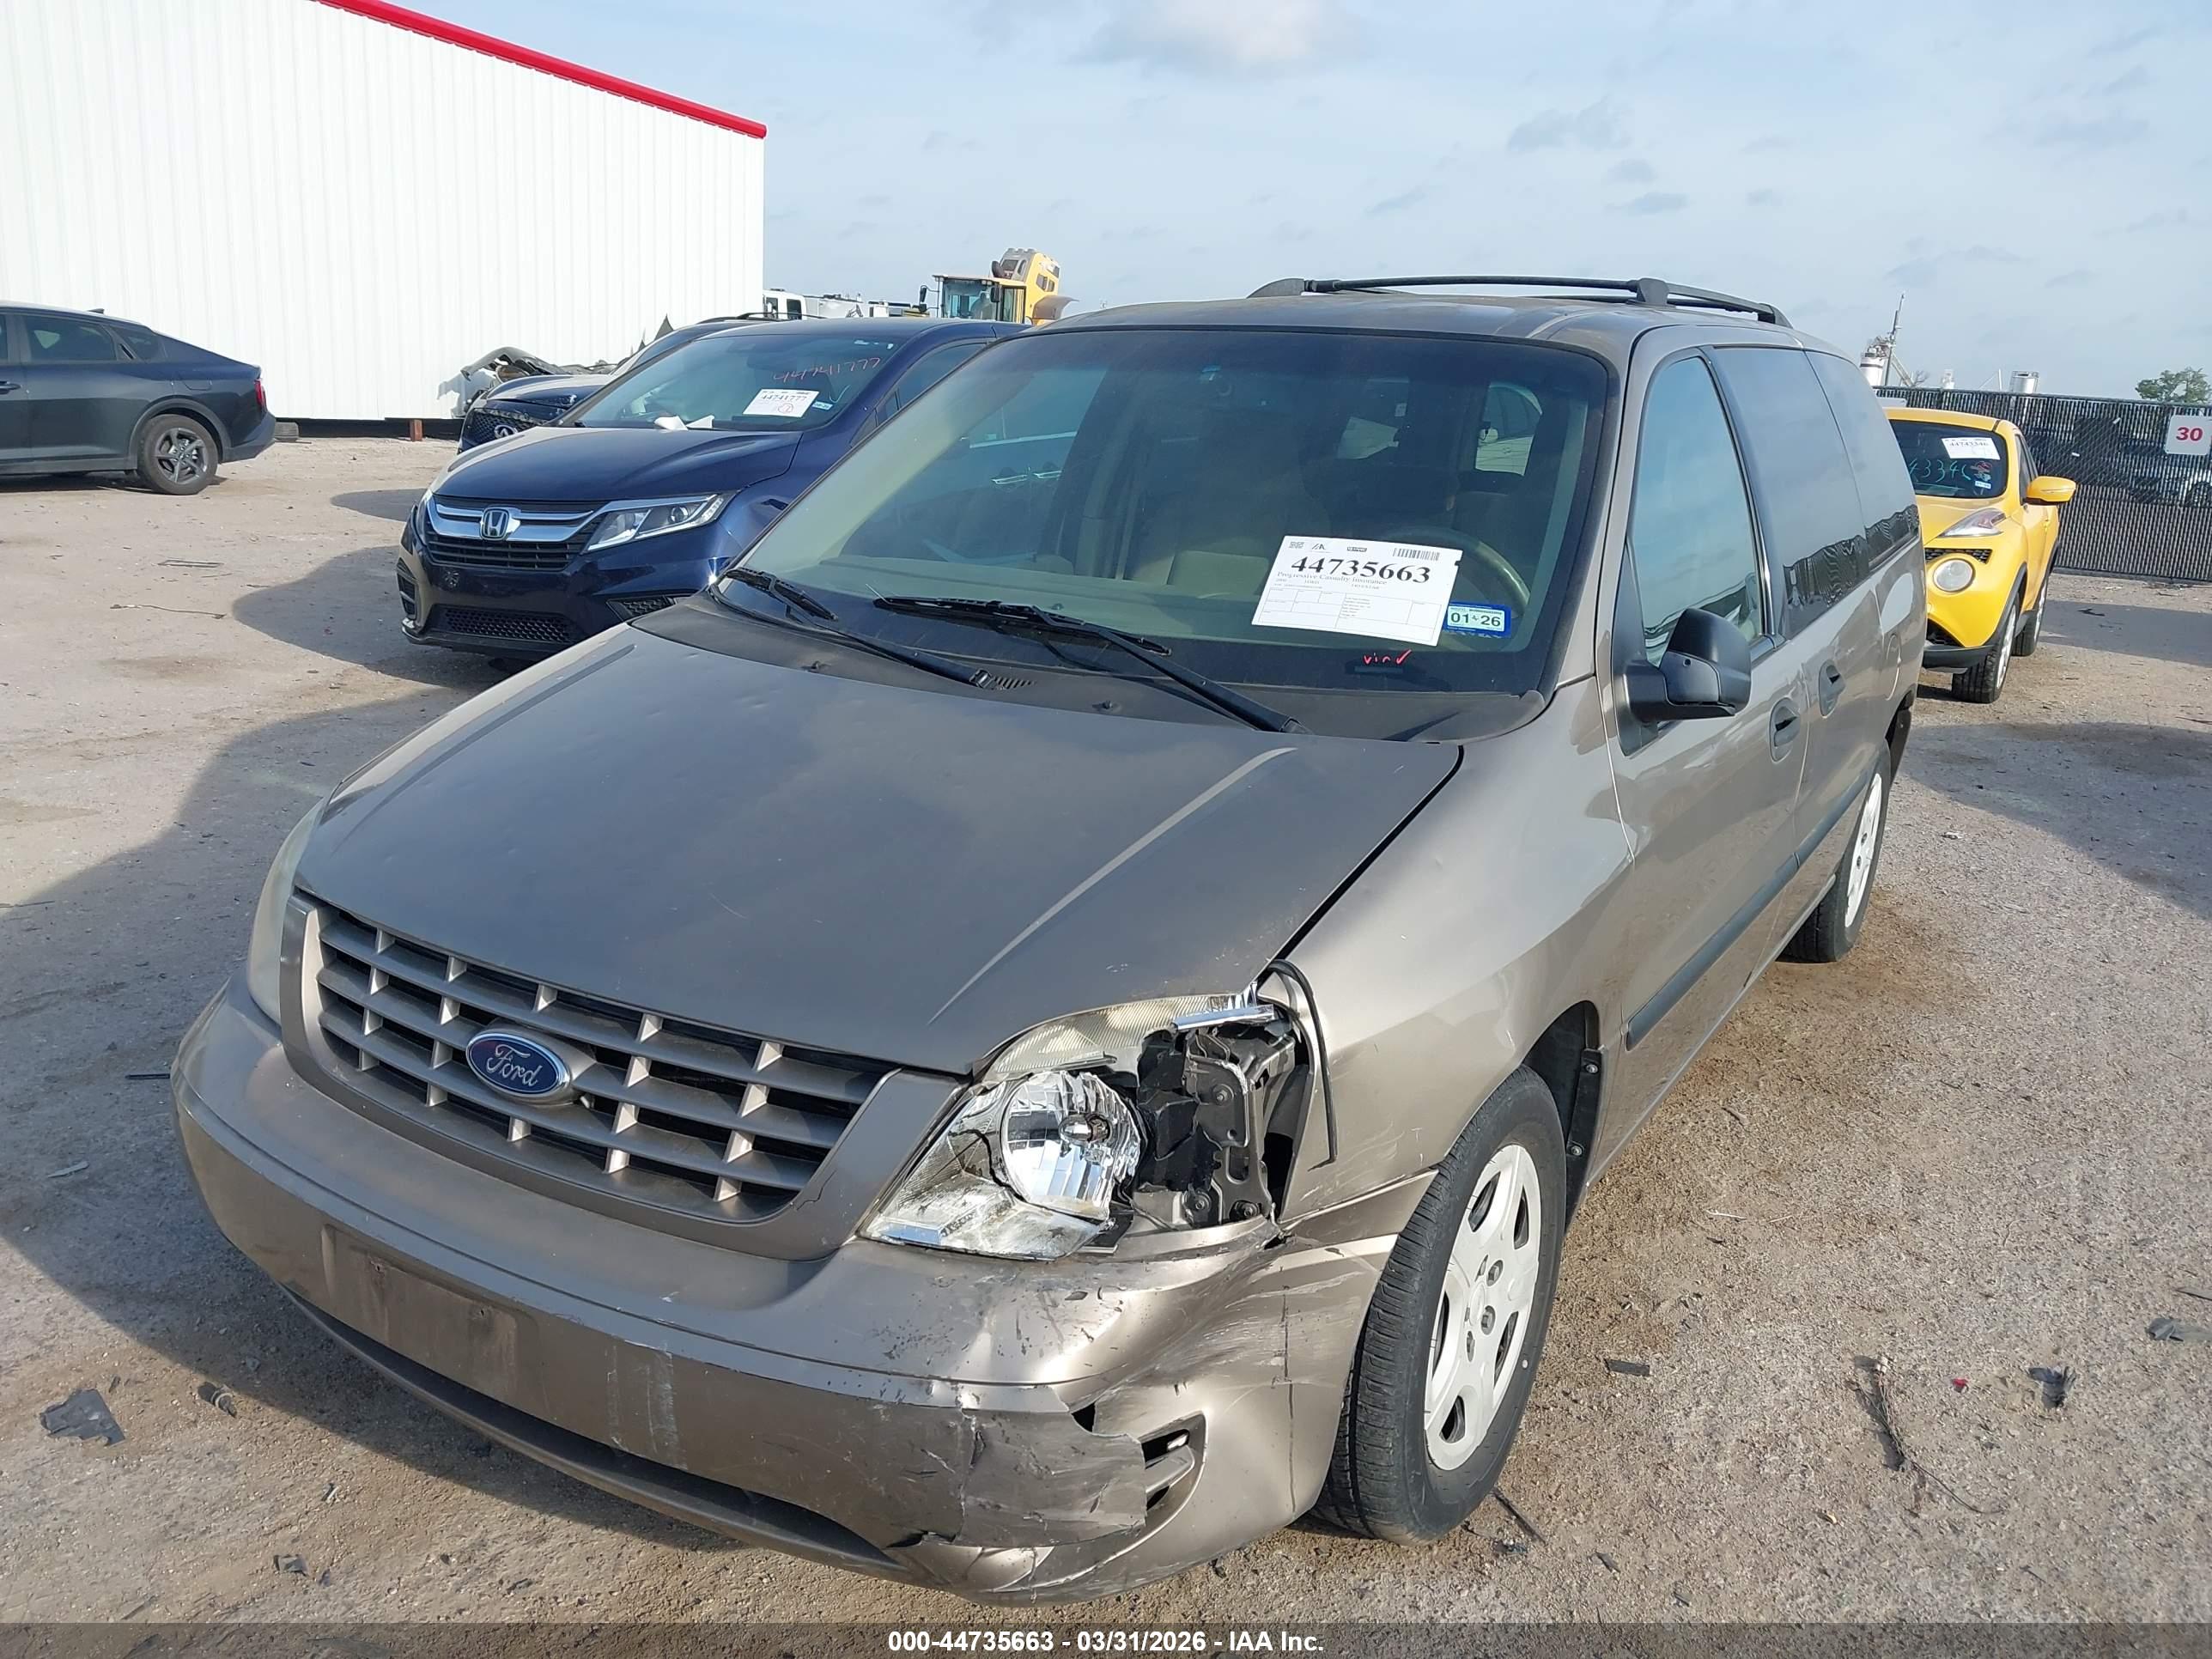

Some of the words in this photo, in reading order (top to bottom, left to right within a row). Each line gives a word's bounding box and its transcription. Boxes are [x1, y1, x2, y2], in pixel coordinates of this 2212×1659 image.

[2175, 426, 2203, 441] 30
[1277, 571, 1318, 580] Progressive
[1291, 556, 1431, 584] 44735663
[1450, 612, 1469, 623] 01
[1480, 615, 1501, 627] 26
[485, 1043, 544, 1087] Ford
